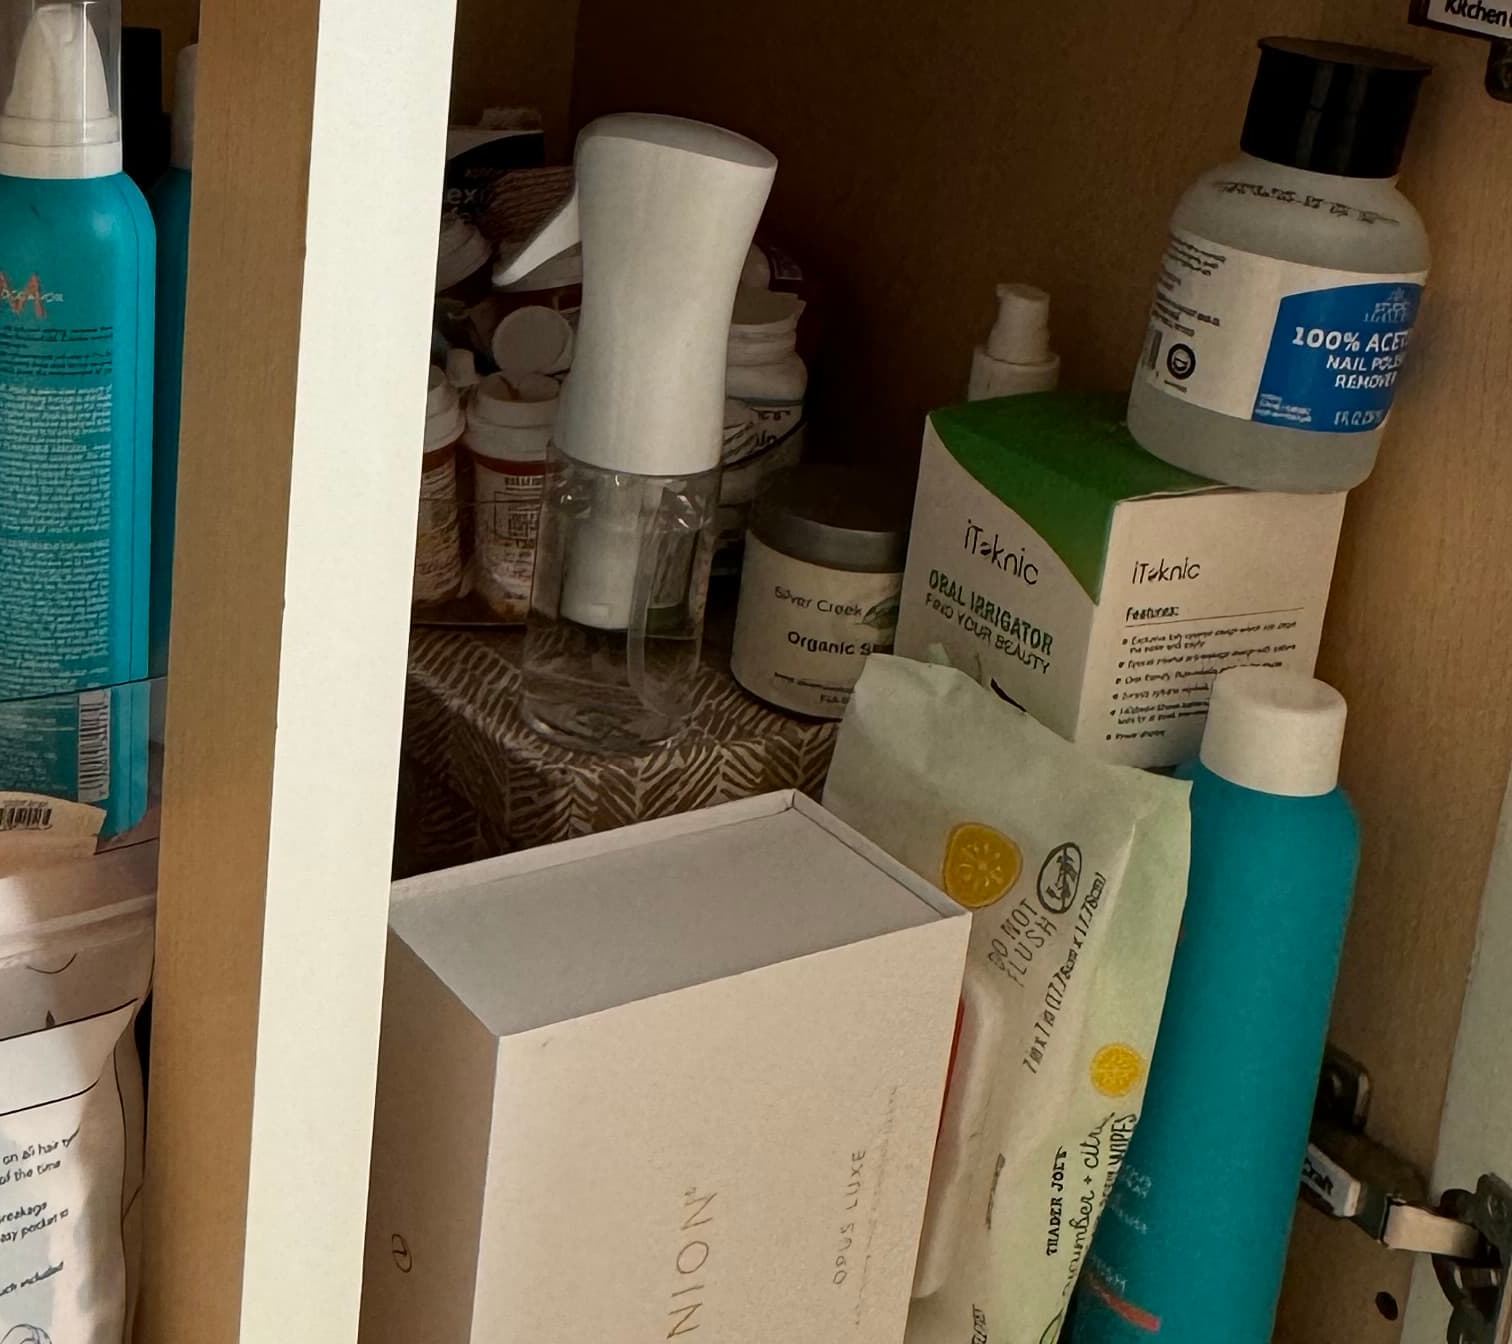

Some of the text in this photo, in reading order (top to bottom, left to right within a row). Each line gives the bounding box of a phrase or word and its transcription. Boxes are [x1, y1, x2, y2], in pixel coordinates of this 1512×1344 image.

[1291, 326, 1409, 355] 100% ACET
[1326, 354, 1403, 373] NAIL POLIS
[1334, 372, 1397, 390] REMOVE
[928, 568, 967, 607] ORAL
[969, 590, 1055, 656] IRRIGATOR
[787, 631, 856, 656] Organic
[957, 605, 994, 644] YOUR
[994, 634, 1051, 675] BEAUTY
[1000, 897, 1039, 941] NOT
[832, 1150, 867, 1286] OPUS LUXE
[666, 1191, 718, 1340] NION
